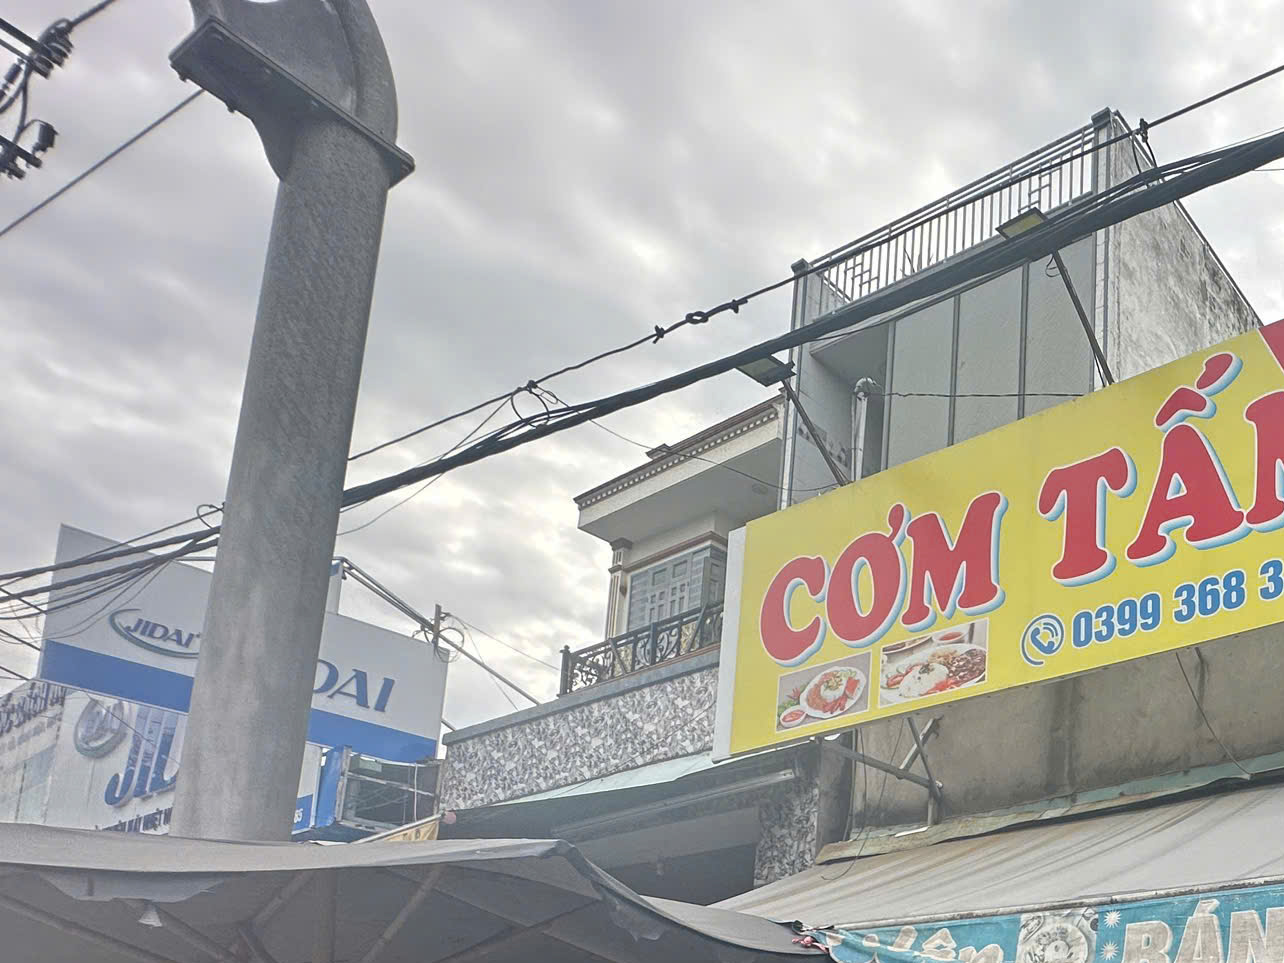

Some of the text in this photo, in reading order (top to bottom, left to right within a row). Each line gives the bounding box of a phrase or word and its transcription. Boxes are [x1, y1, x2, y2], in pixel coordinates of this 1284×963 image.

[760, 492, 1007, 666] CƠM
[1072, 591, 1161, 648] 0399
[1173, 567, 1246, 625] 368
[312, 659, 395, 712] DAI
